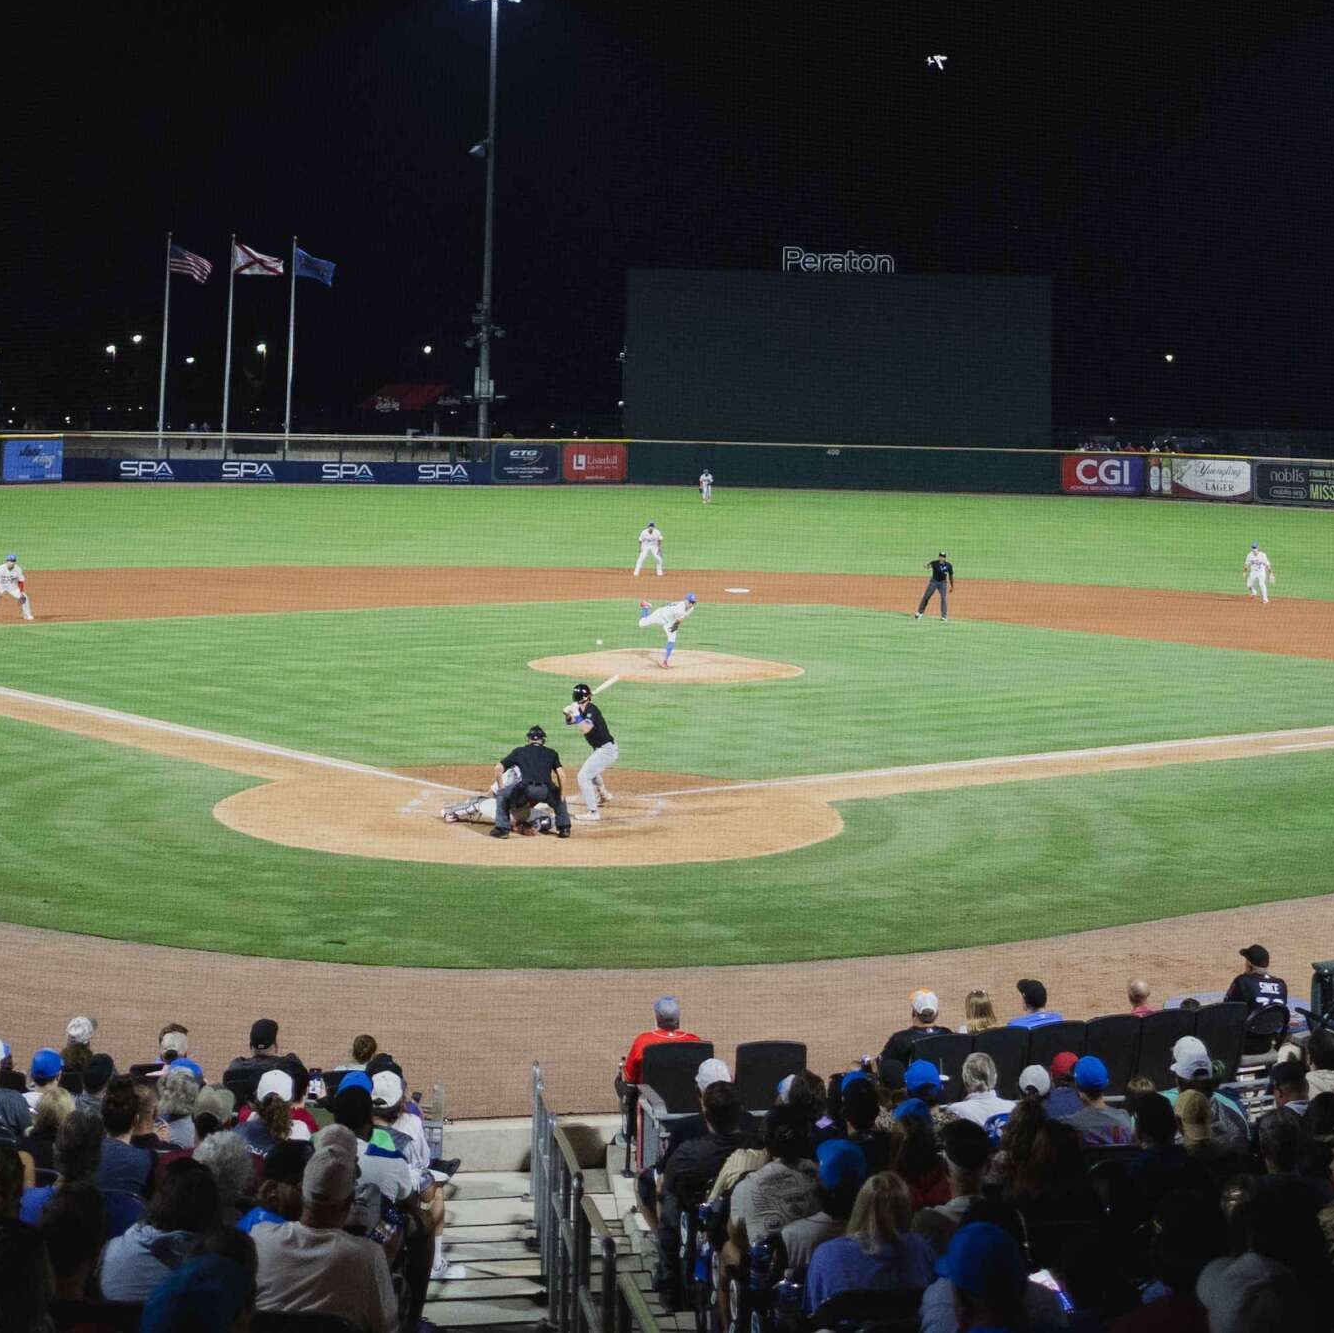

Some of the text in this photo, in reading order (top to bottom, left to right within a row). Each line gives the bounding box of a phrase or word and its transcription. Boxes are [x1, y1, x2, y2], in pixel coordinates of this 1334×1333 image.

[782, 246, 895, 273] Peraton
[119, 461, 173, 479] SPA
[221, 461, 275, 479] SPA
[322, 463, 374, 479] SPA
[418, 463, 469, 479] SPA
[1075, 459, 1130, 484] CGI
[1270, 469, 1305, 483] noblis
[1205, 481, 1235, 493] LAGER
